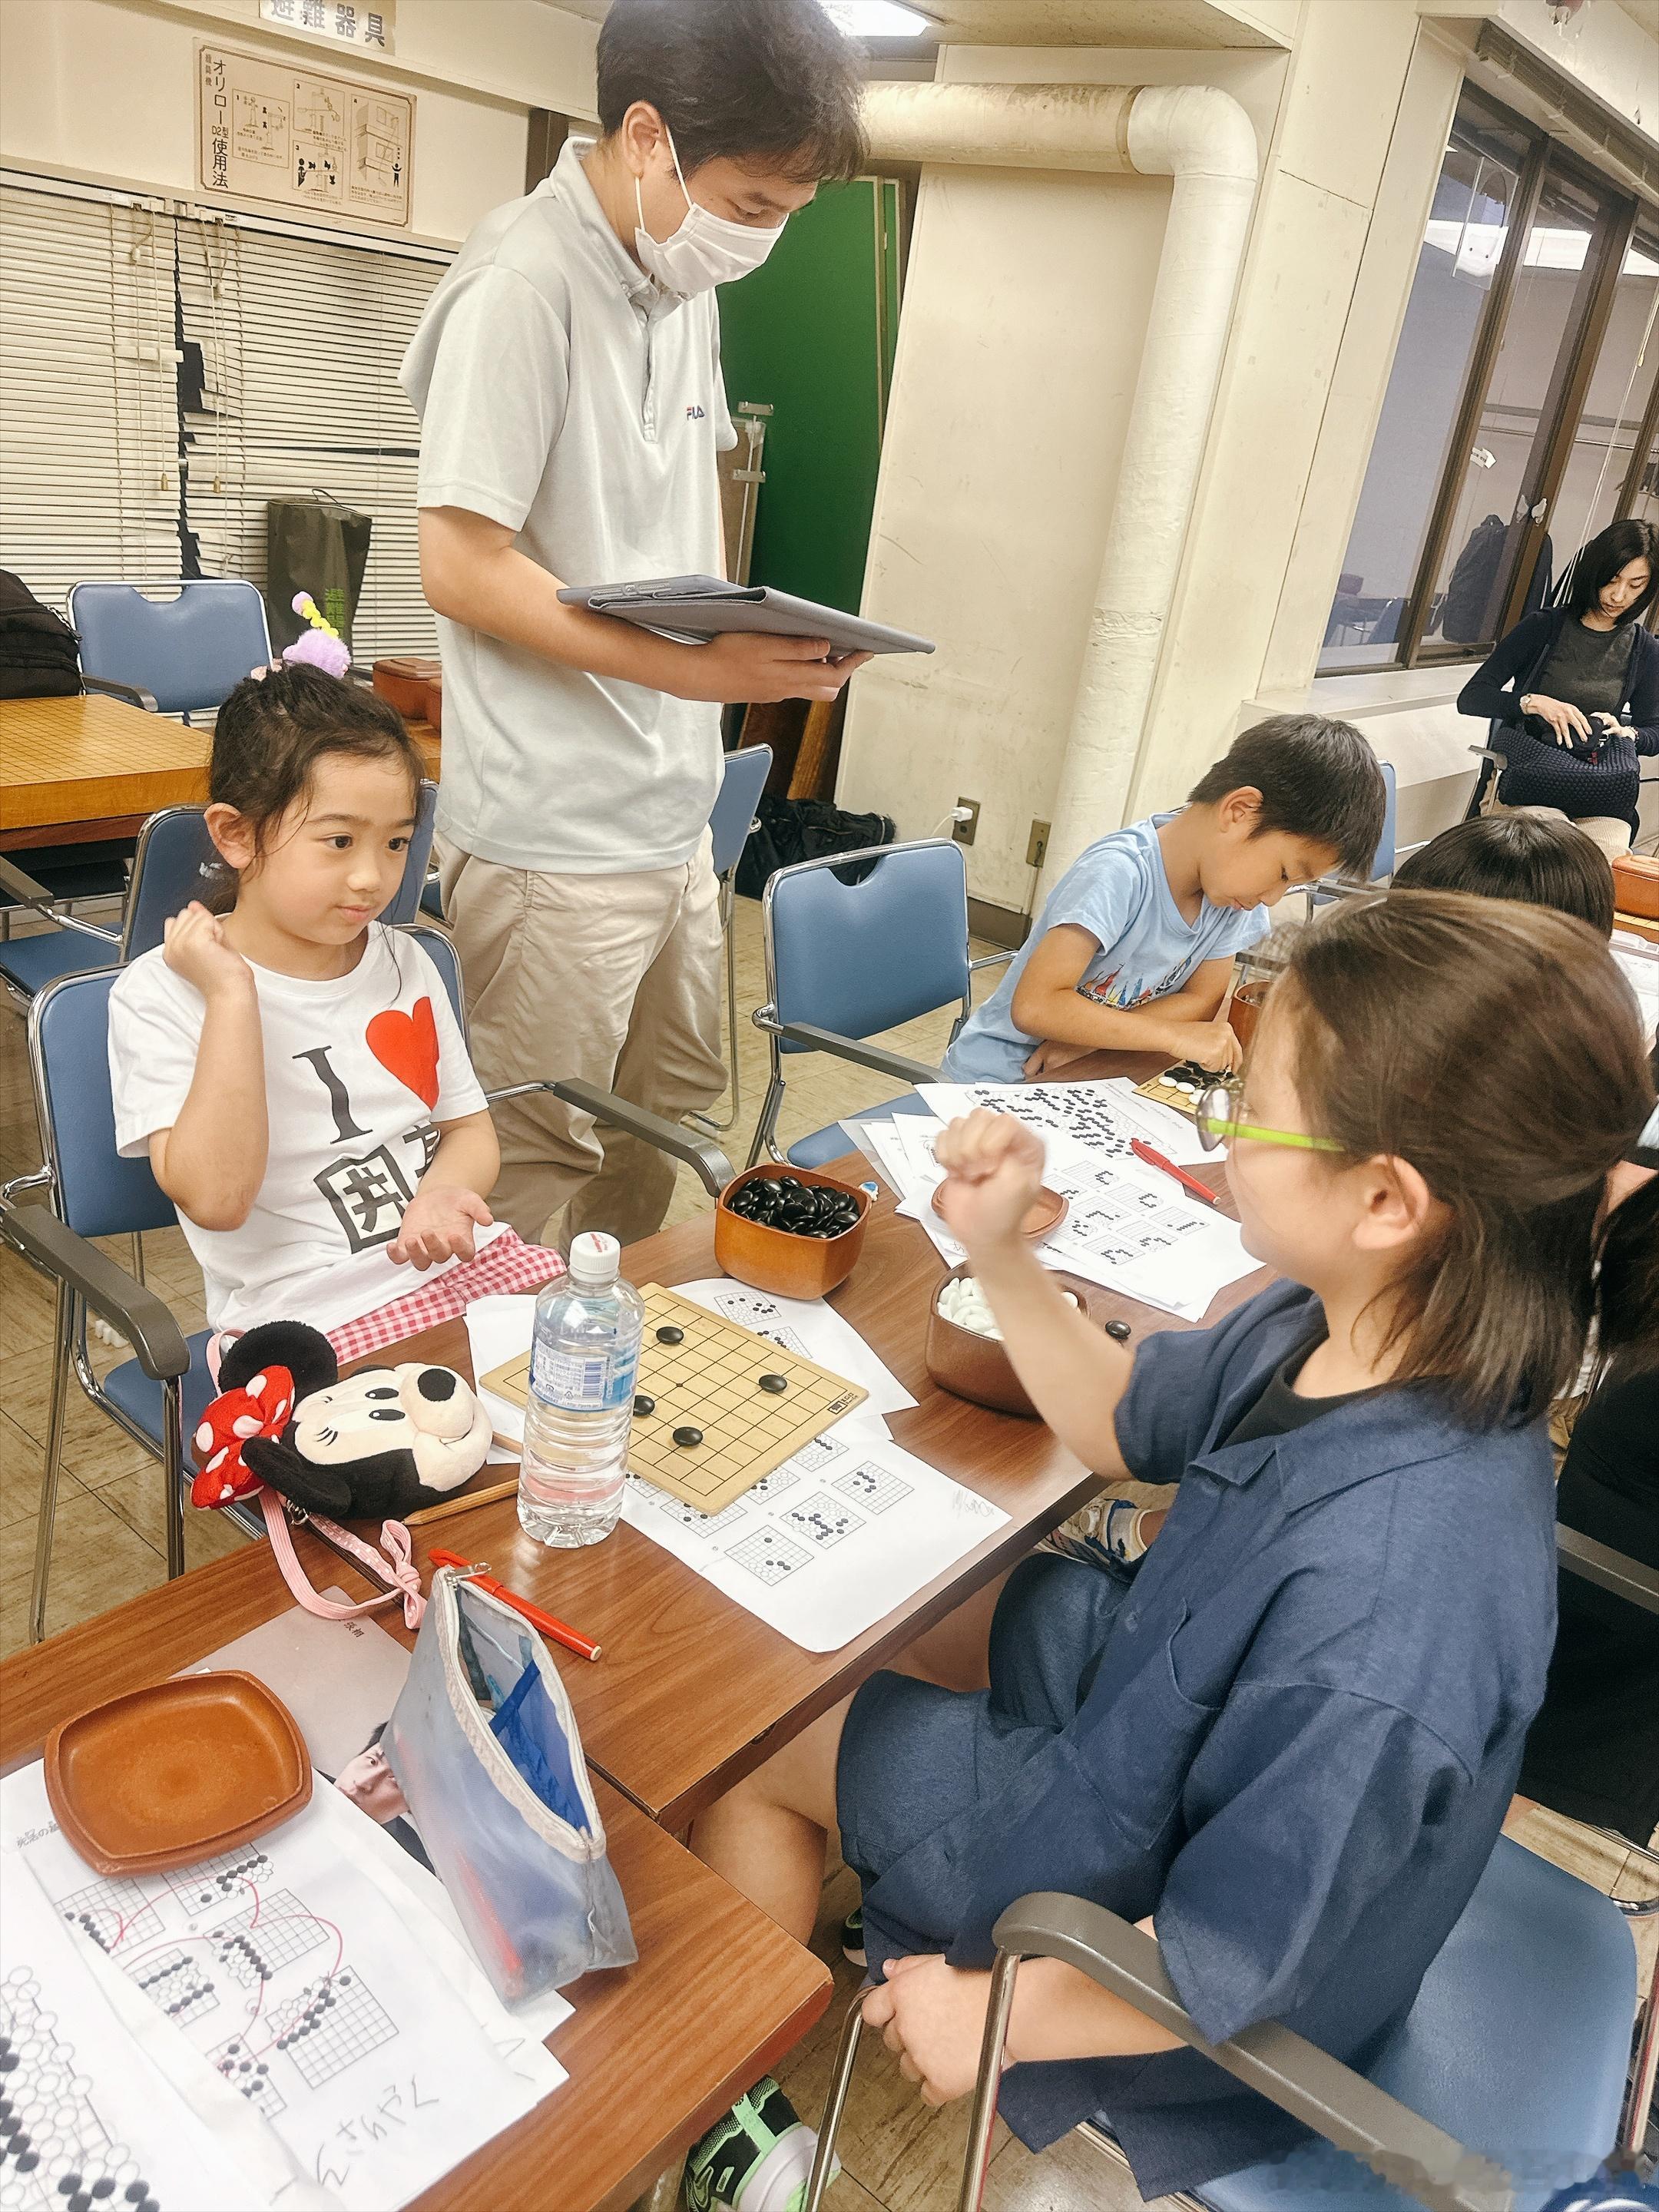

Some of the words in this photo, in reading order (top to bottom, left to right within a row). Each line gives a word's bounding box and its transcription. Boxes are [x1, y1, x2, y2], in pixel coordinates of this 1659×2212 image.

[271, 0, 385, 47] 避難器具
[292, 1045, 374, 1144] I
